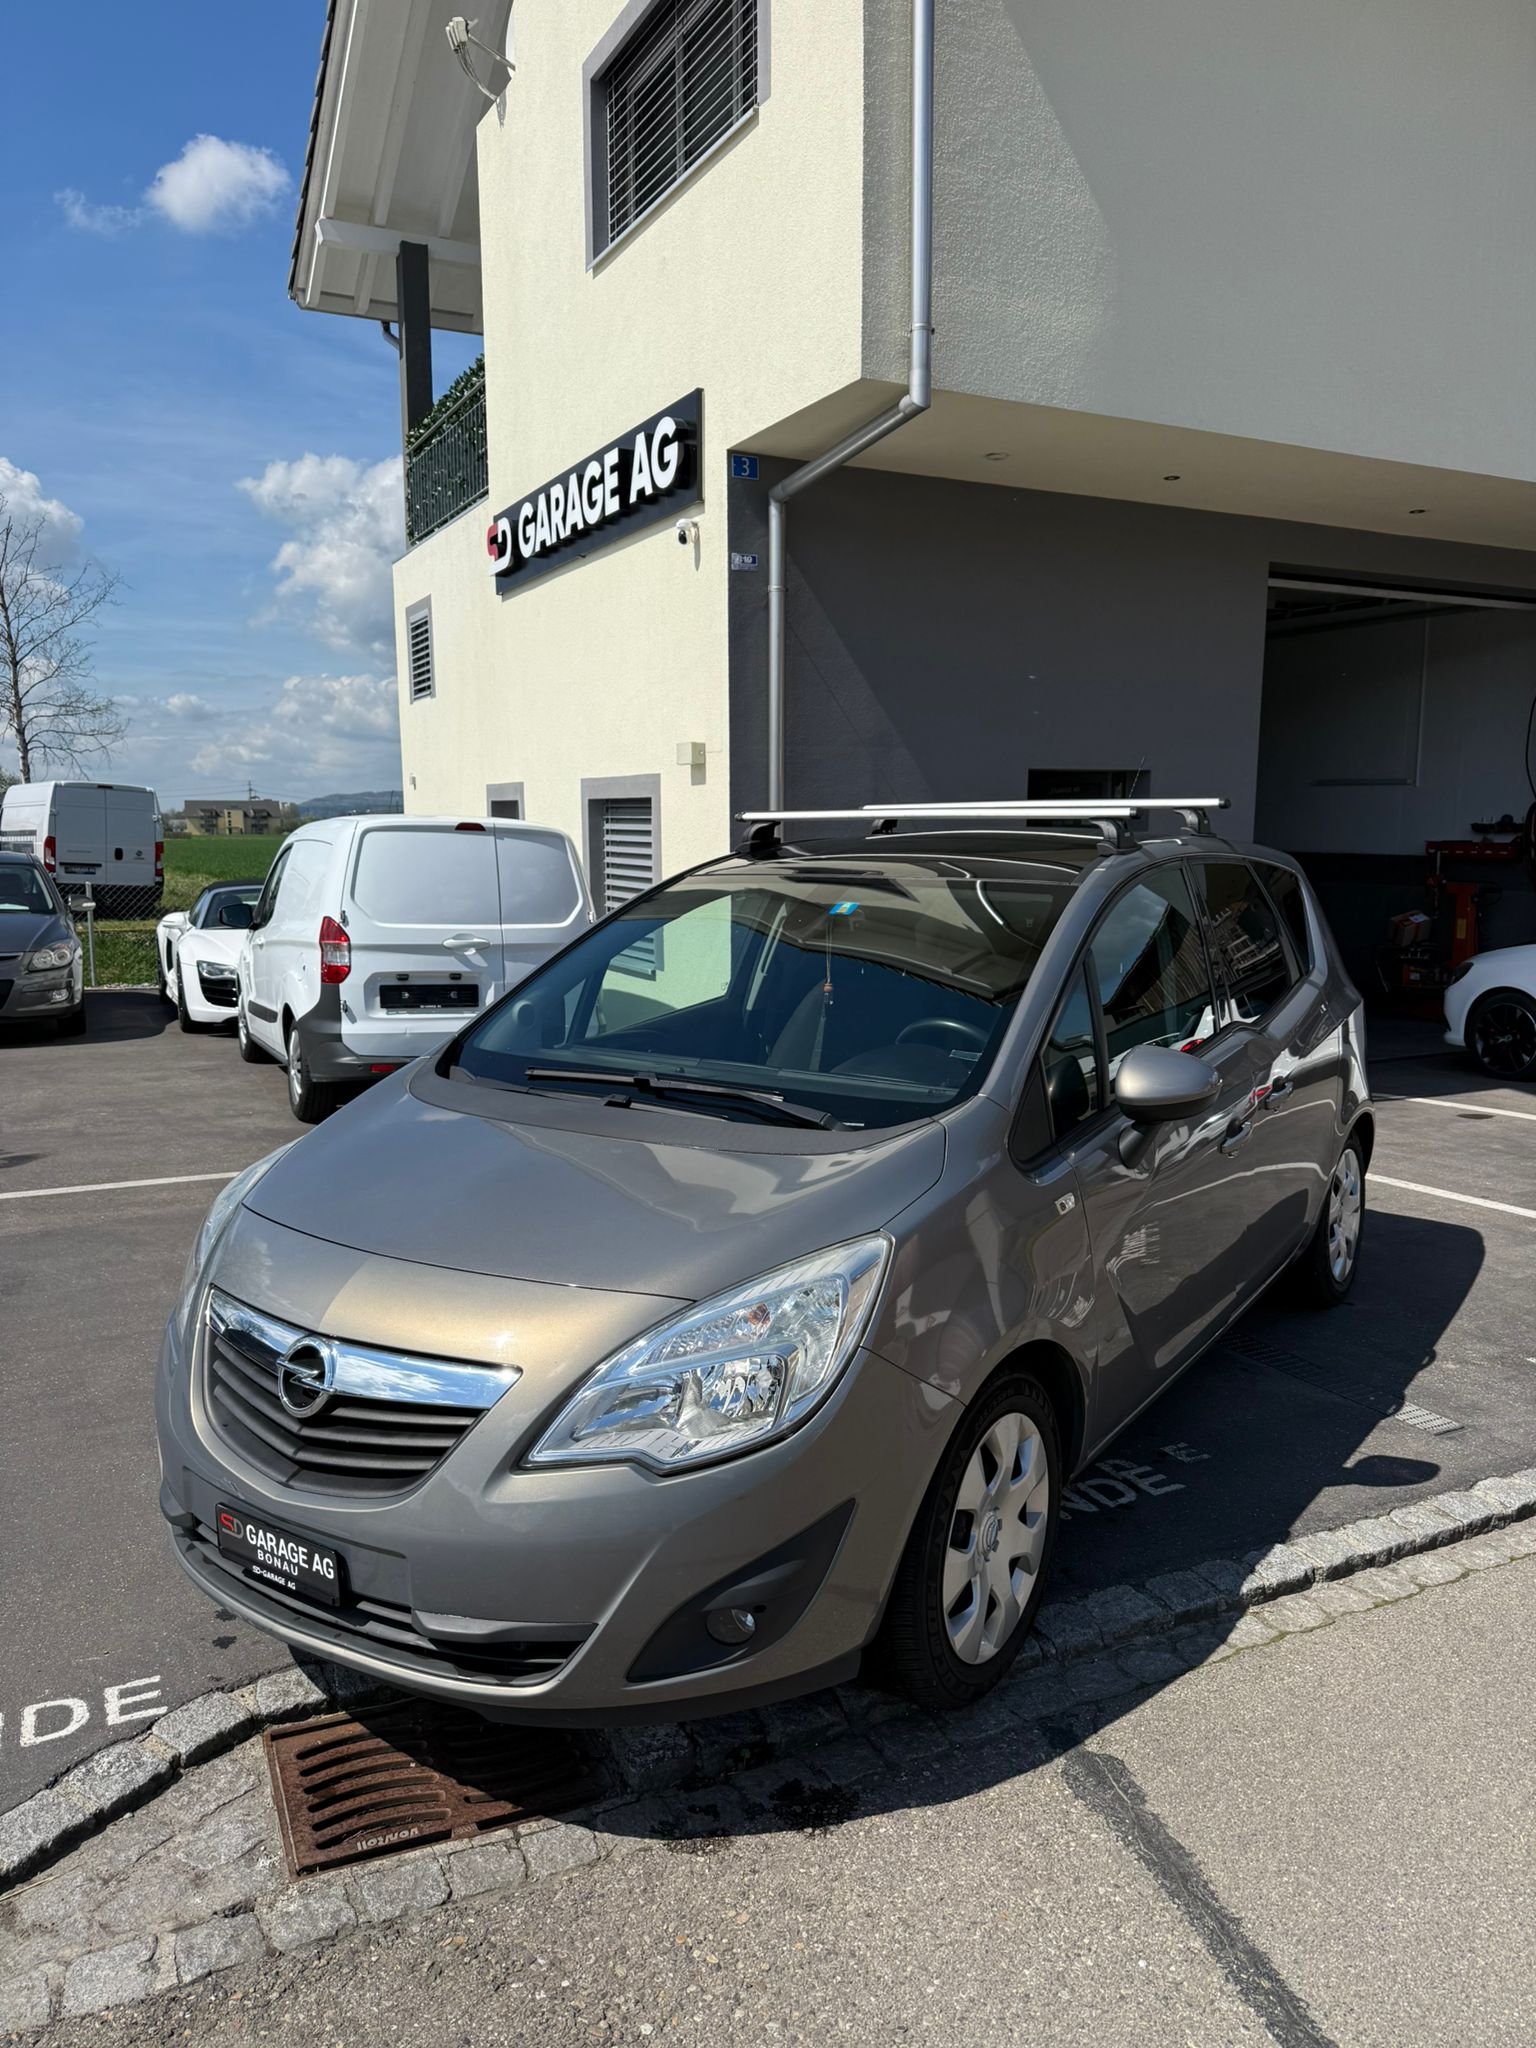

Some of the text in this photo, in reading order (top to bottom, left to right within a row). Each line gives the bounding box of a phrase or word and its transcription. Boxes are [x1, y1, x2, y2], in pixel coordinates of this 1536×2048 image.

[518, 446, 620, 558] GARAGE
[629, 415, 679, 504] AG
[740, 457, 750, 476] 3
[220, 1512, 335, 1580] SD GARAGE AG
[257, 1549, 299, 1576] BONAU
[252, 1565, 296, 1591] SD-GARAGE AG
[0, 1675, 169, 1748] DE
